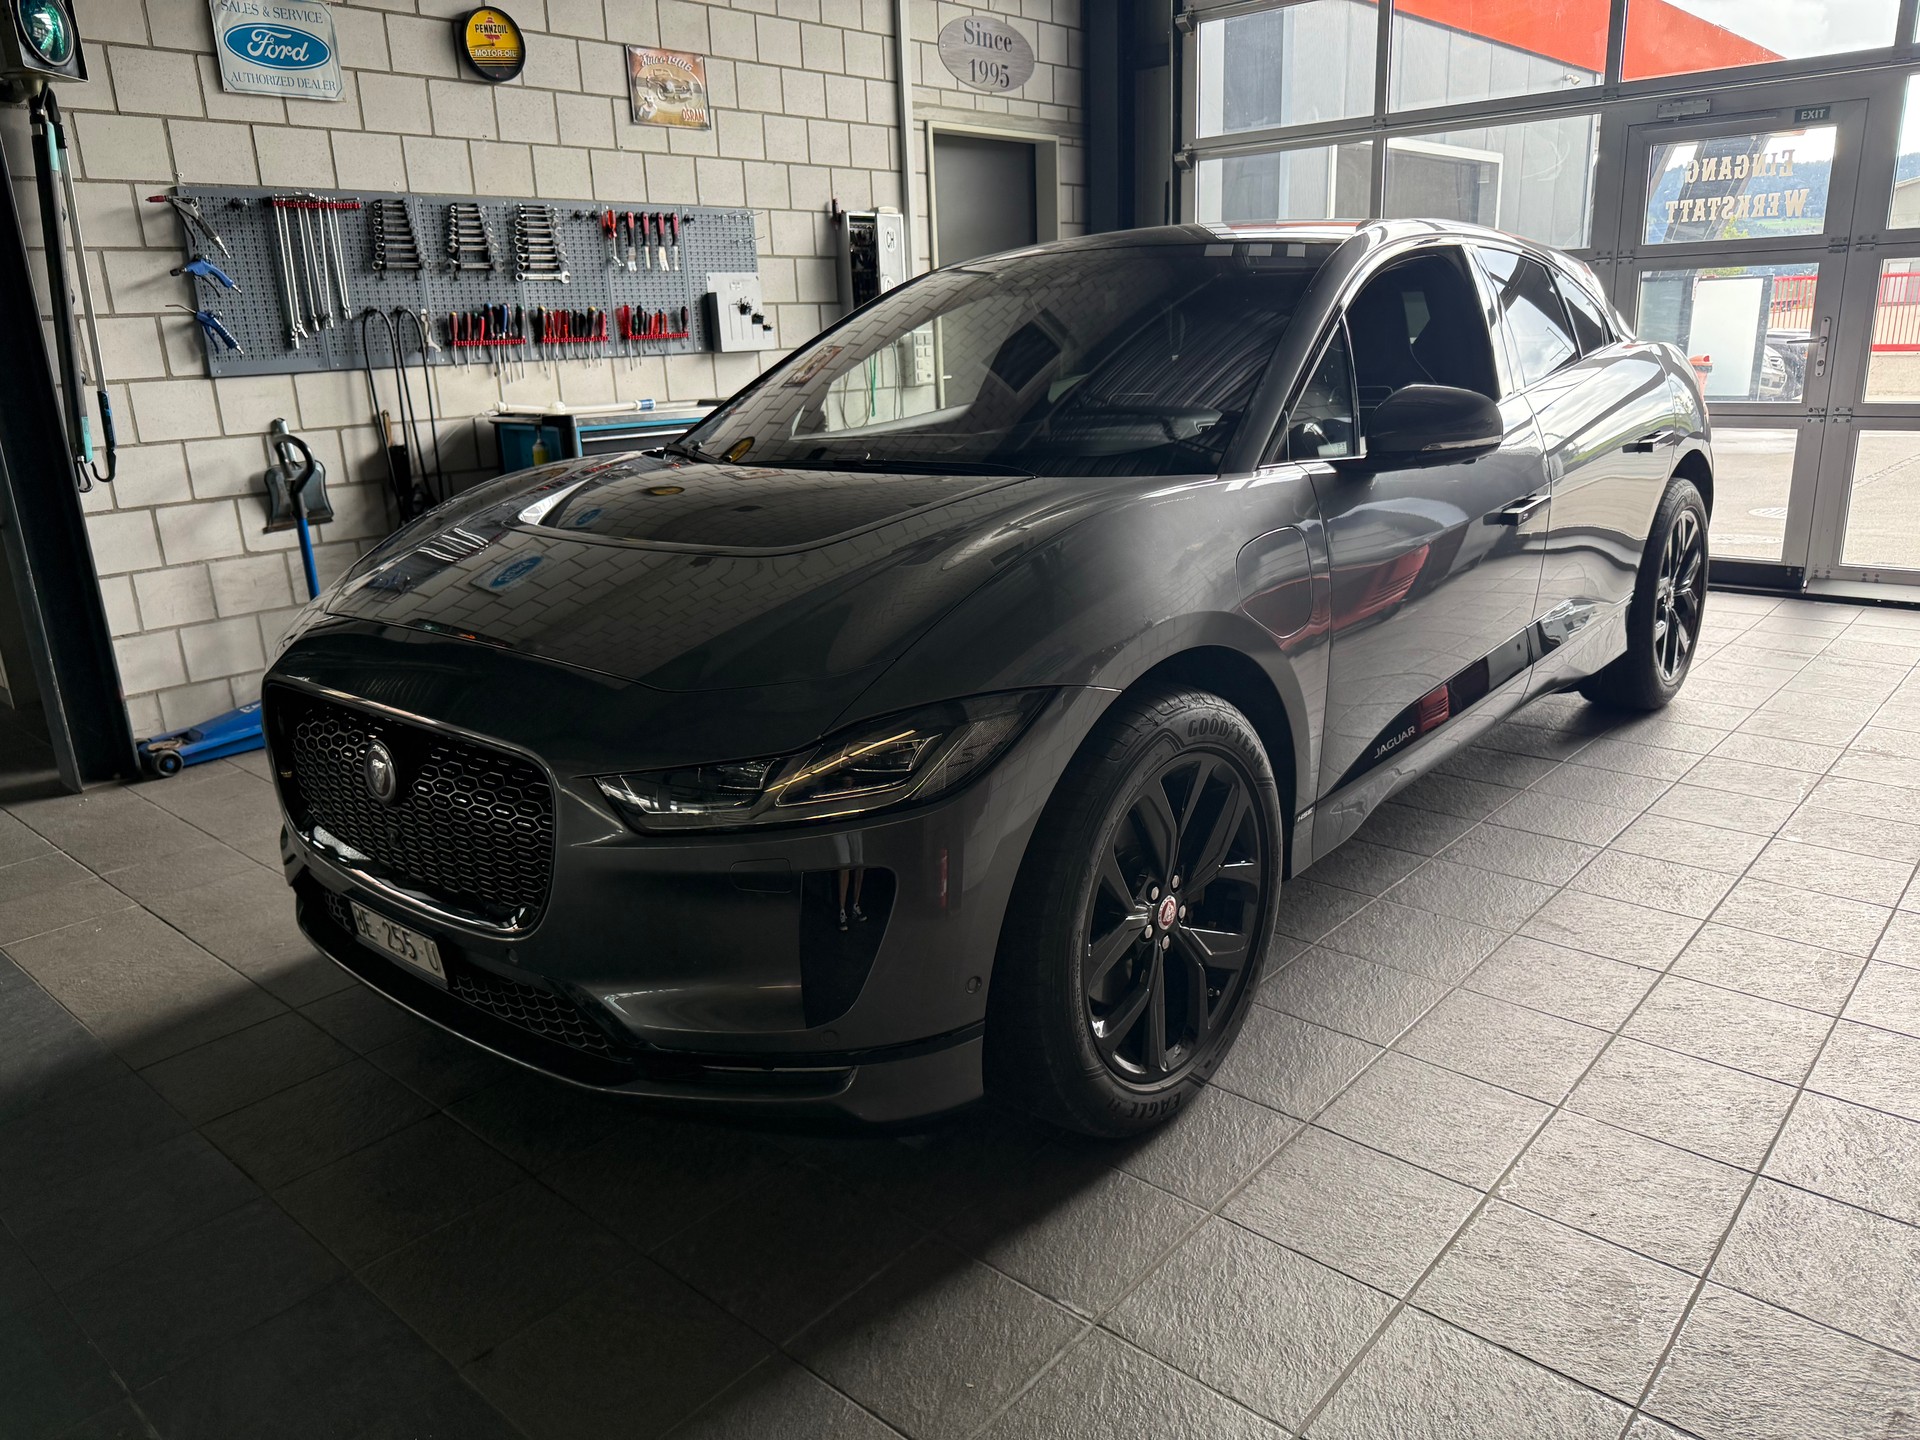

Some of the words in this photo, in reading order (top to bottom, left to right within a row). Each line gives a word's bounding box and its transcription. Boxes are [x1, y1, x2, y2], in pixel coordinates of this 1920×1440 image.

[221, 0, 259, 16] SALES
[262, 6, 271, 18] &
[272, 6, 323, 24] SERVICE
[474, 23, 509, 34] PENNZOIL
[963, 19, 1013, 53] Since
[247, 29, 310, 62] Ford
[475, 49, 503, 57] MOTOR
[667, 55, 694, 72] 1906
[968, 58, 1010, 88] 1995
[231, 71, 295, 88] AUTHORIZED
[297, 76, 337, 91] DEALER
[681, 108, 706, 122] OSRAM
[1801, 108, 1827, 120] EXIT
[1374, 725, 1416, 759] JAGUAR
[382, 919, 418, 960] 255
[1126, 1092, 1181, 1119] EAGLE
